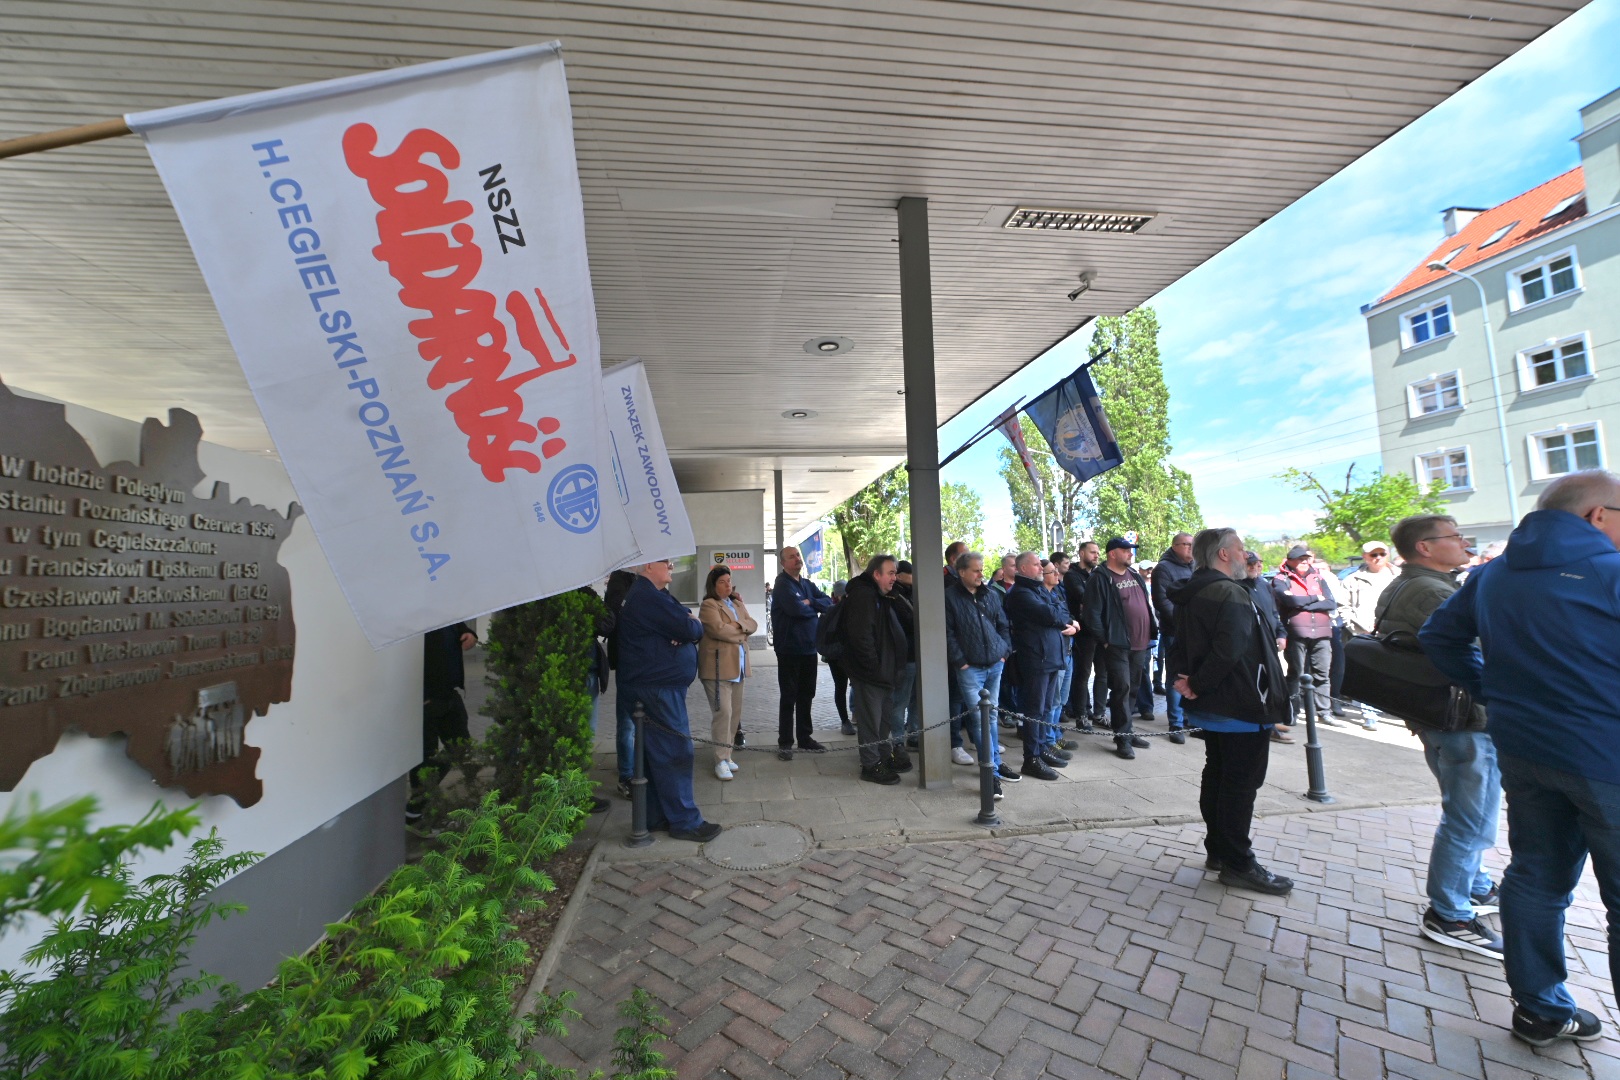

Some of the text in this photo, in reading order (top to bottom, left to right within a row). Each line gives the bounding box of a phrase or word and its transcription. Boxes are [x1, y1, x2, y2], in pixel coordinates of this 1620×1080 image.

[477, 163, 526, 254] NSZZ
[251, 139, 451, 581] H.CEGIELSKI-POZNAŃ S.A.
[621, 385, 672, 536] ZWIĄZEK ZAWODOWY
[1, 455, 185, 504] W hołdzie Poległym
[79, 498, 187, 531] Poznańskiego
[193, 513, 244, 534] Czerwca
[249, 521, 277, 538] 1956,
[533, 502, 546, 522] 1846
[11, 525, 218, 555] w tym Cegielszczakom:
[26, 556, 144, 577] Franciszkowi
[152, 559, 217, 580] Lipskiemu
[3, 586, 121, 608] Czesławowi
[129, 585, 226, 604] Jackowskiemu
[42, 613, 140, 640] Bogdanowi
[150, 611, 167, 629] M.
[26, 650, 78, 671] Panu
[89, 637, 177, 663] Wacławowi
